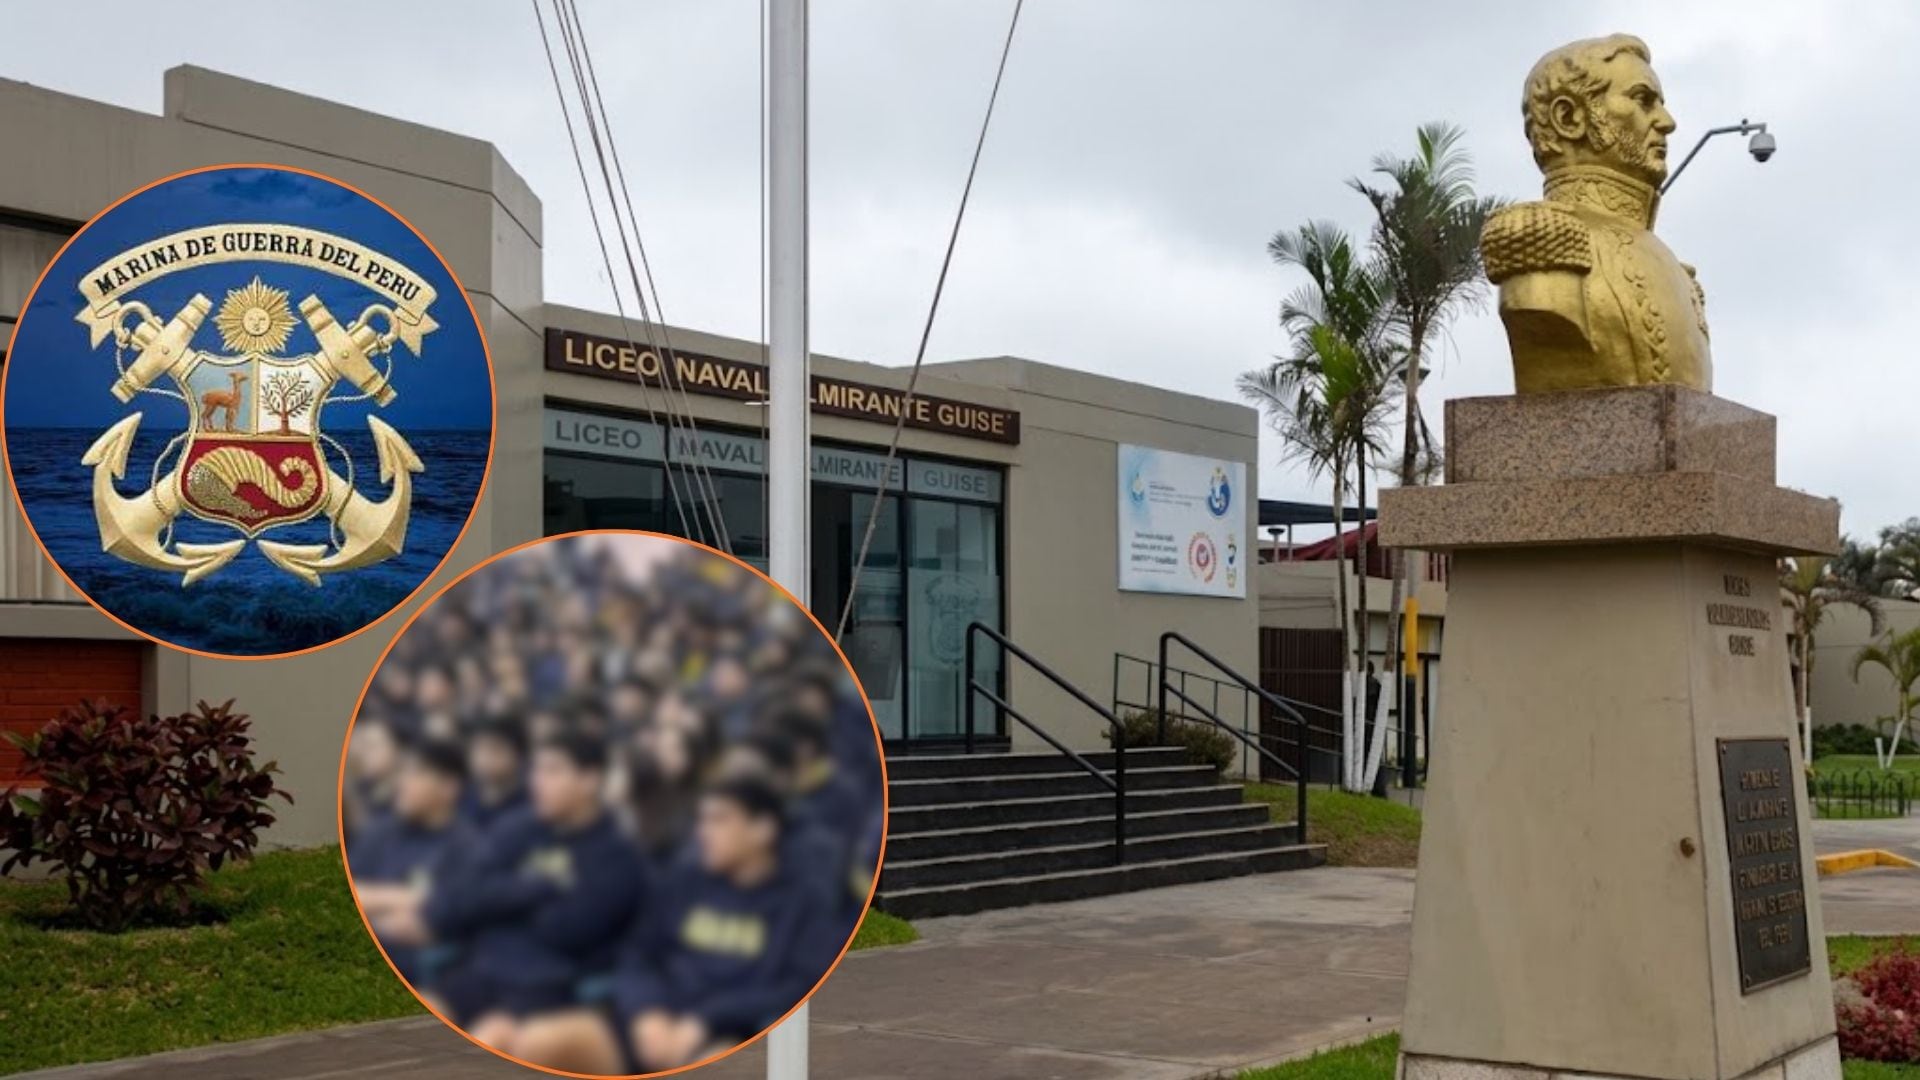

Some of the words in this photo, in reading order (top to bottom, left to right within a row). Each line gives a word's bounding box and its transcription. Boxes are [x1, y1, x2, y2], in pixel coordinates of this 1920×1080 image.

[565, 338, 660, 376] LICEO
[675, 357, 770, 394] NAVAL
[556, 421, 642, 450] LICEO
[678, 435, 763, 465] NAVAL
[924, 470, 986, 494] GUISE
